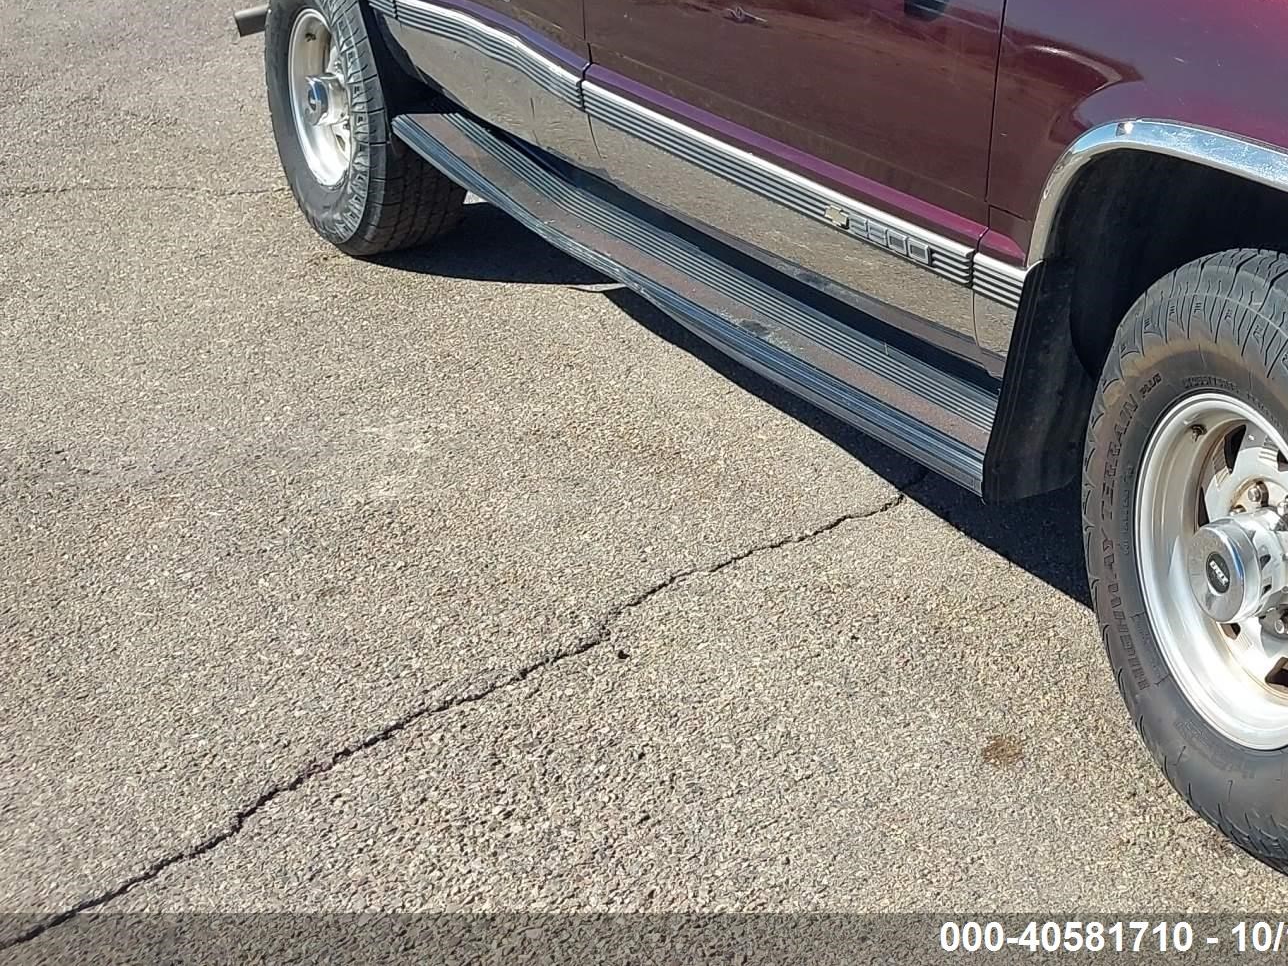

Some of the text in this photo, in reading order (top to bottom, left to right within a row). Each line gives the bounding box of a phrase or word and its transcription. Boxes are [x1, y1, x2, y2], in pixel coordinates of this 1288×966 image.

[849, 213, 930, 265] 2500
[1139, 373, 1162, 398] PLUS
[1102, 393, 1138, 520] TERRAIN
[1101, 527, 1151, 691] HIGHWAY
